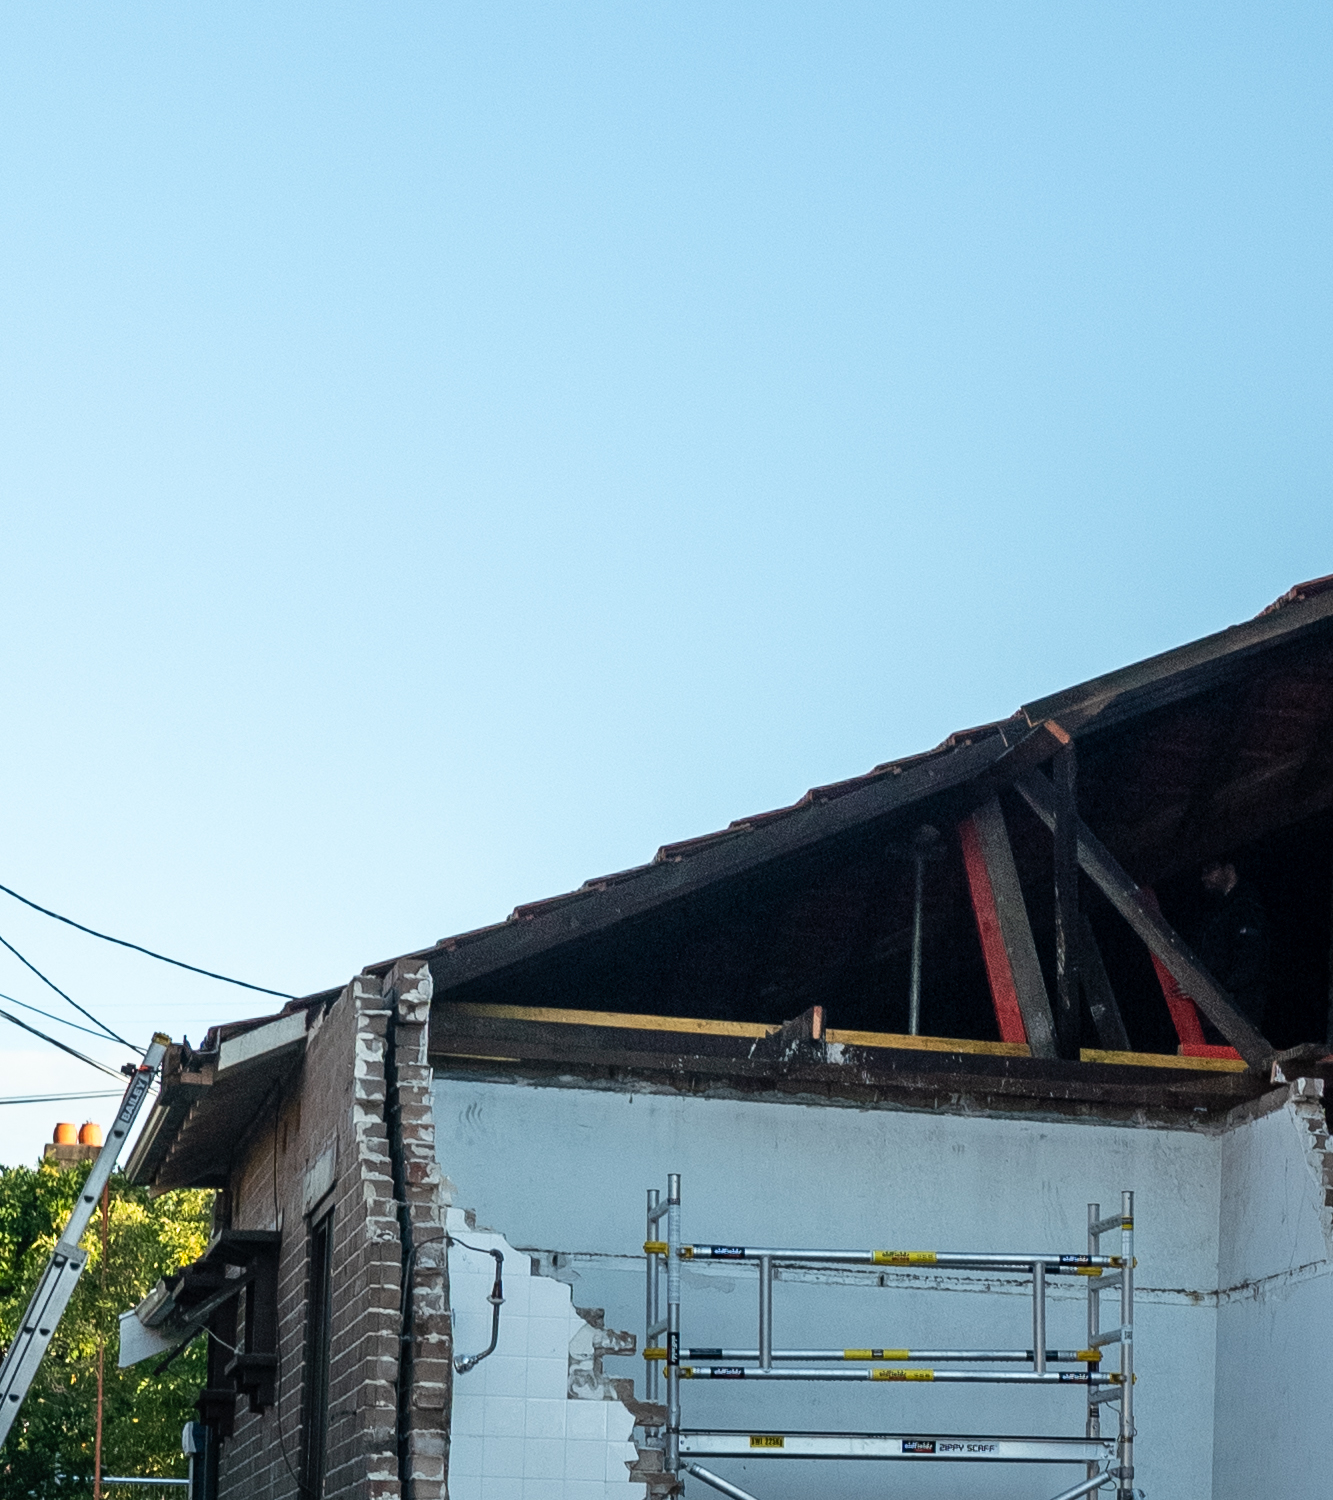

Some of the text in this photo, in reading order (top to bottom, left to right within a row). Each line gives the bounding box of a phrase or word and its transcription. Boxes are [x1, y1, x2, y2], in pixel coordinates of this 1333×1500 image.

[121, 1079, 147, 1122] BAILEY
[939, 1444, 995, 1452] ZIPPY SCAFF
